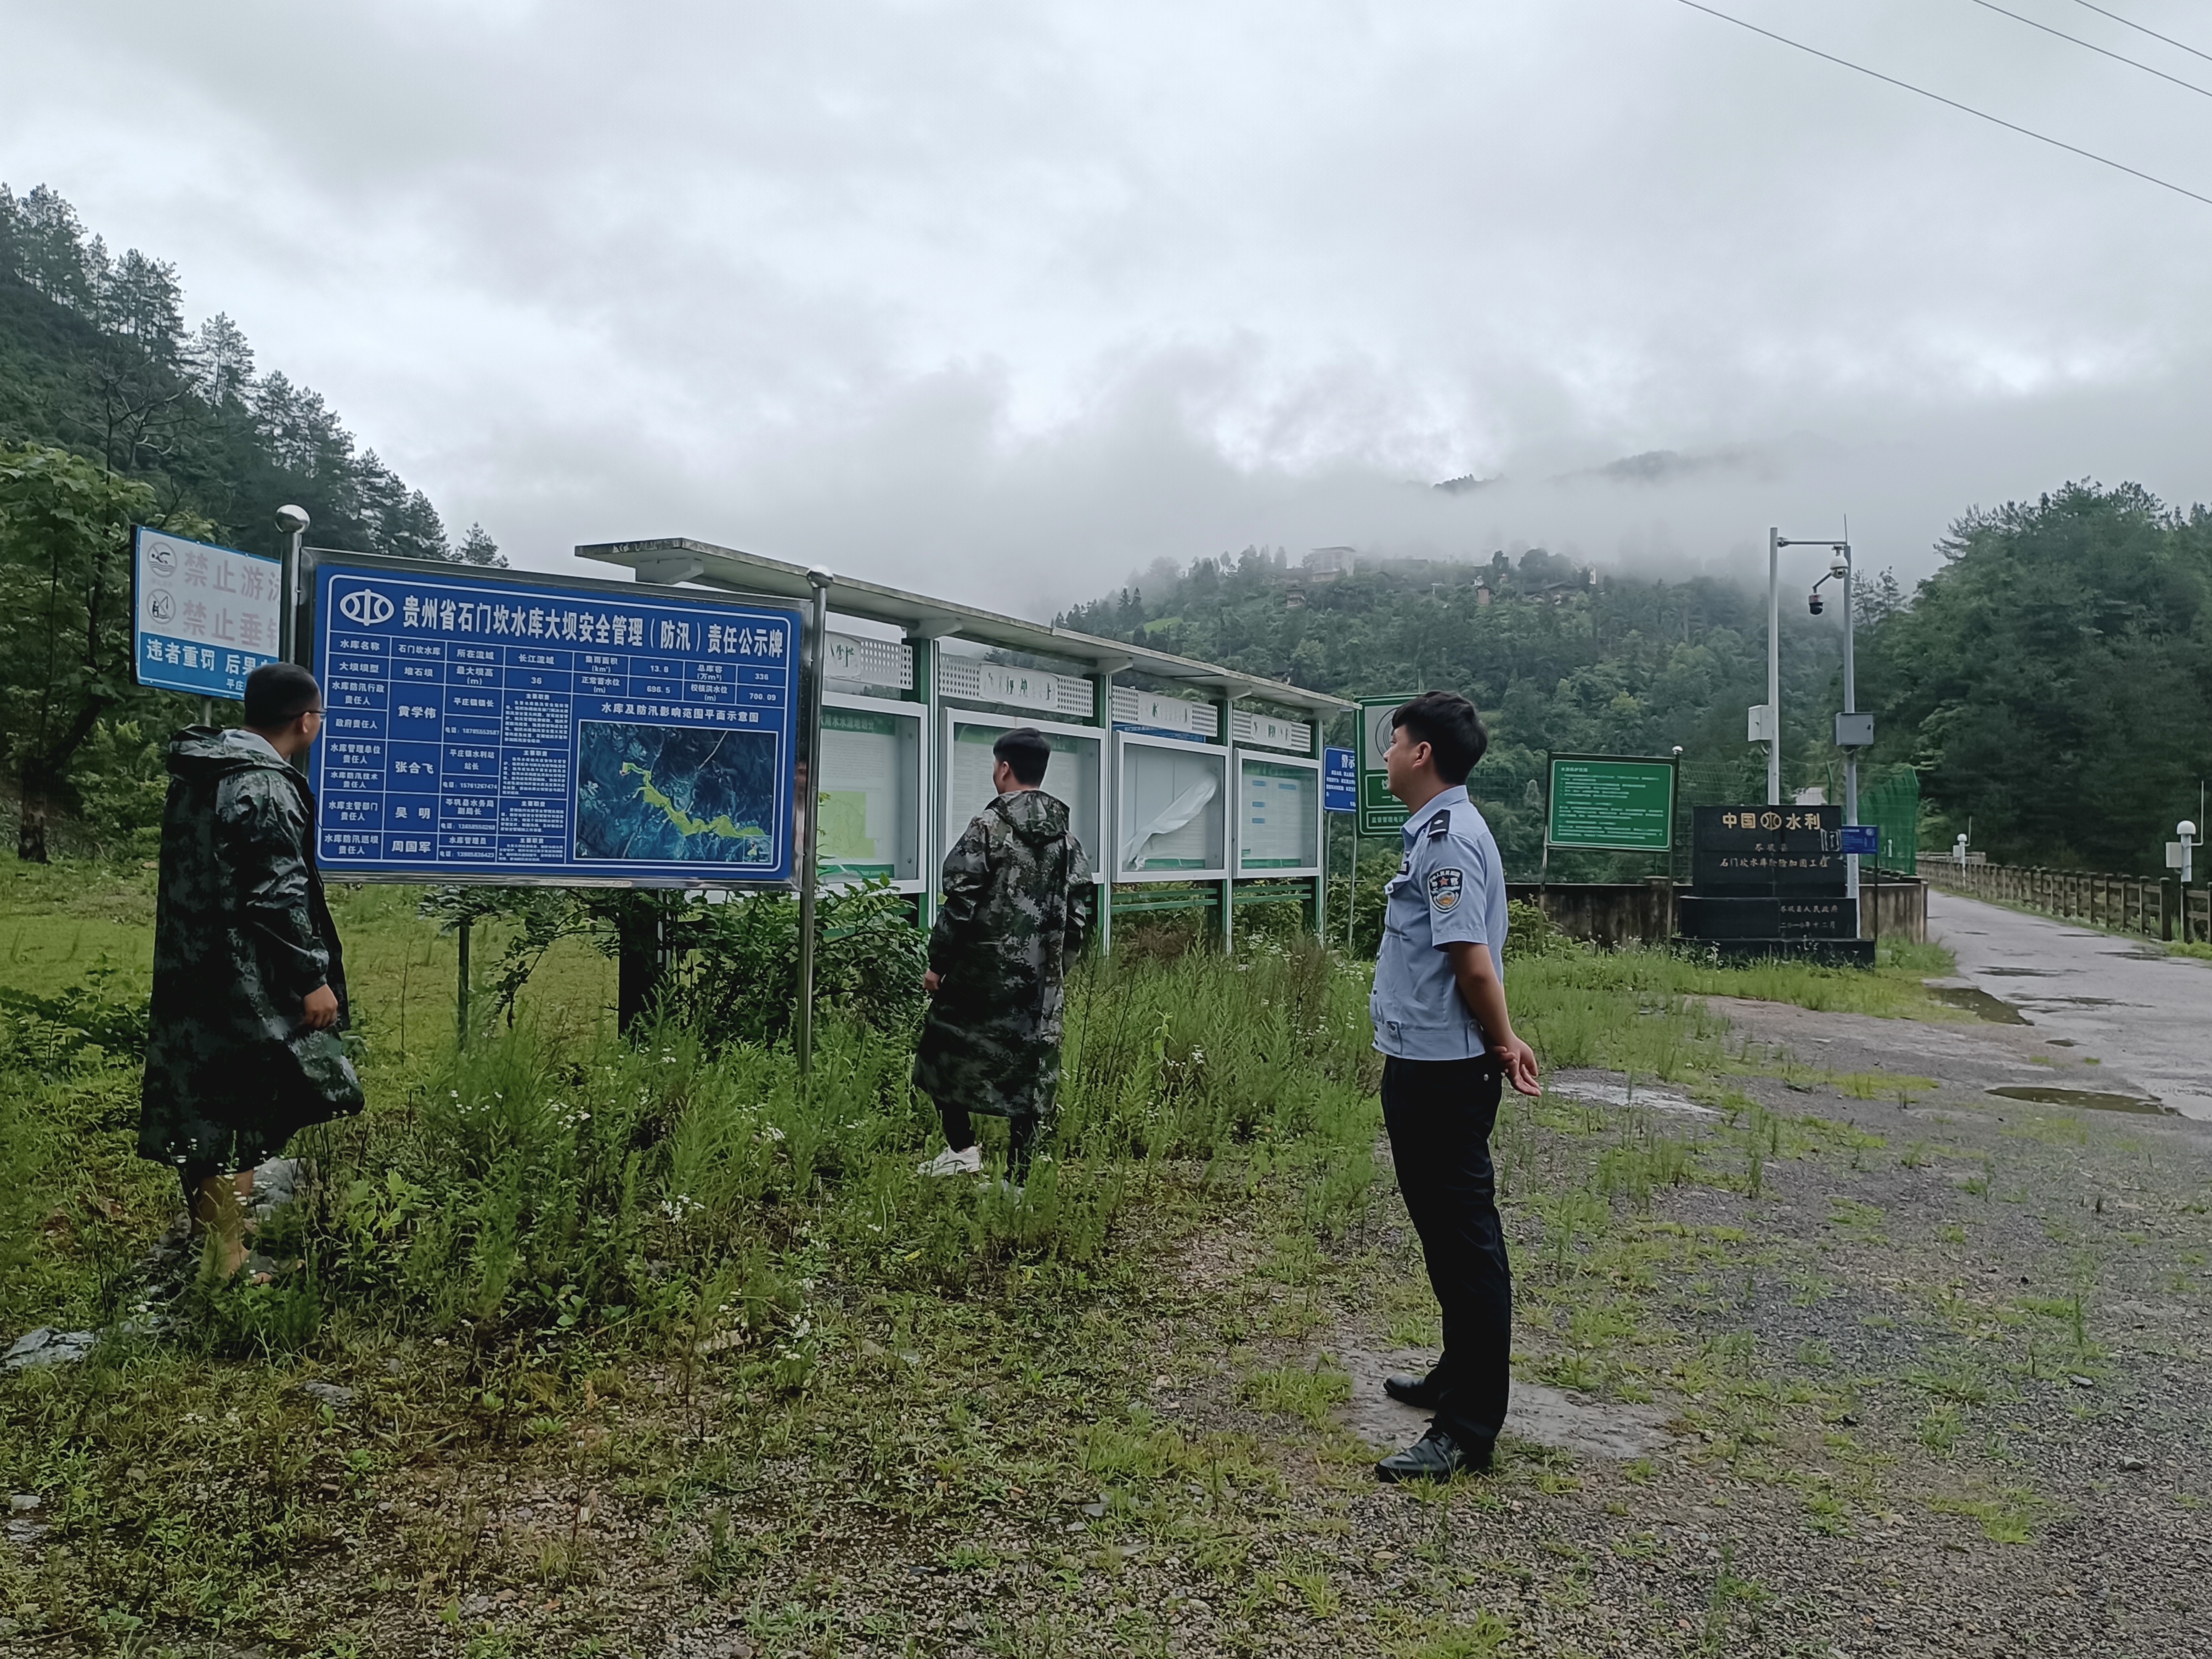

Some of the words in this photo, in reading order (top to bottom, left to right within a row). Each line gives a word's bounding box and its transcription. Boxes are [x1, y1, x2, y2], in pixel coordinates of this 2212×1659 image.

[340, 639, 380, 651] 水库名称
[398, 644, 441, 656] 石门坎水库
[146, 639, 216, 672] 违者重罚
[225, 653, 269, 676] 后果
[457, 649, 494, 660] 所在流域
[518, 653, 554, 664] 长江流域
[340, 662, 379, 673] 大坝坝型
[404, 667, 433, 677] 堆石坝
[456, 665, 493, 677] 最大坝高
[332, 681, 385, 693] 水库防汛行政
[345, 695, 370, 705] 责任人
[398, 706, 436, 719] 黄学伟
[601, 702, 759, 723] 水库及防汛影响范围平面示意图
[336, 719, 377, 729] 政府责任人
[330, 743, 380, 754] 水库管理单位
[343, 754, 367, 764] 责任人
[396, 761, 434, 774] 张合飞
[331, 771, 377, 780] 水库防汛技术
[329, 800, 377, 811] 水库主管部门
[458, 807, 481, 815] 副局长
[341, 812, 365, 821] 责任人
[1722, 812, 1756, 829] 中国
[1786, 812, 1820, 830] 水利
[338, 845, 365, 854] 责任人
[392, 840, 431, 853] 周国军
